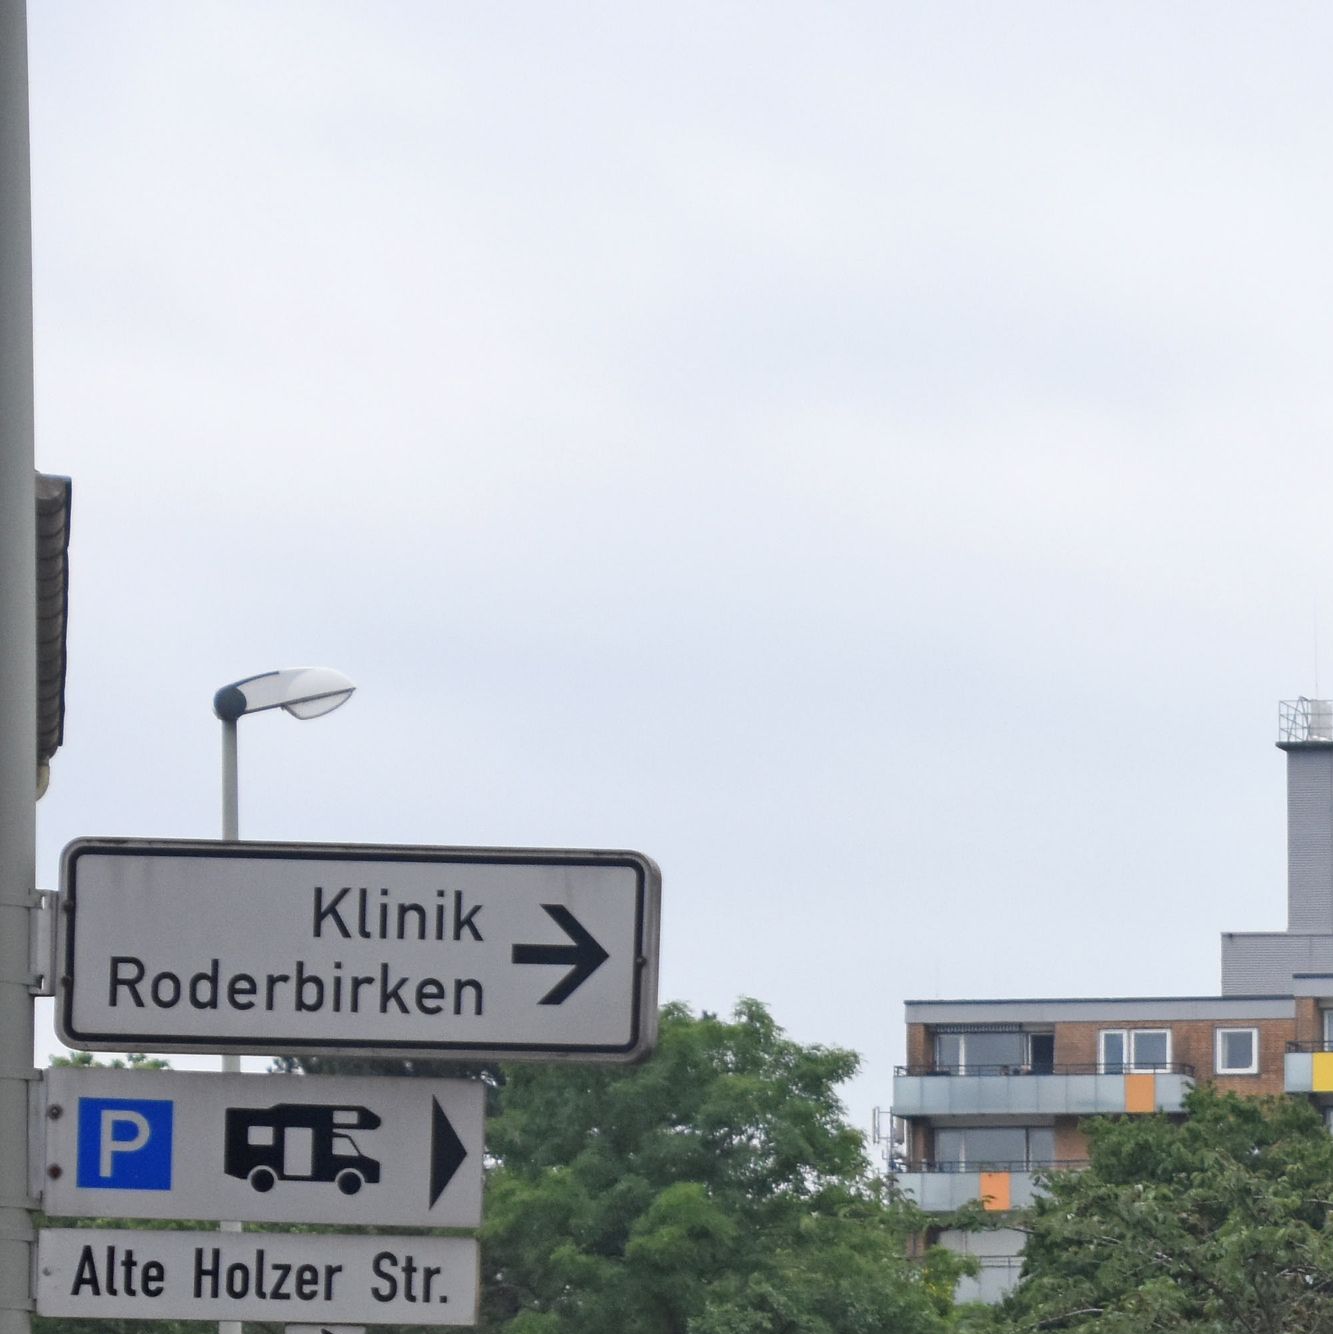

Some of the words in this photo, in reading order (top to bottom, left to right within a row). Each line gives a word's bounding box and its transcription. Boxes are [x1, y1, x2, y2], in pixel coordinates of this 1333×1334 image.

[313, 886, 484, 942] Klinik
[108, 955, 484, 1016] Roderbirken
[99, 1109, 151, 1178] P
[70, 1244, 165, 1298] Alte
[193, 1246, 343, 1301] Holzer
[370, 1250, 449, 1304] Str.
